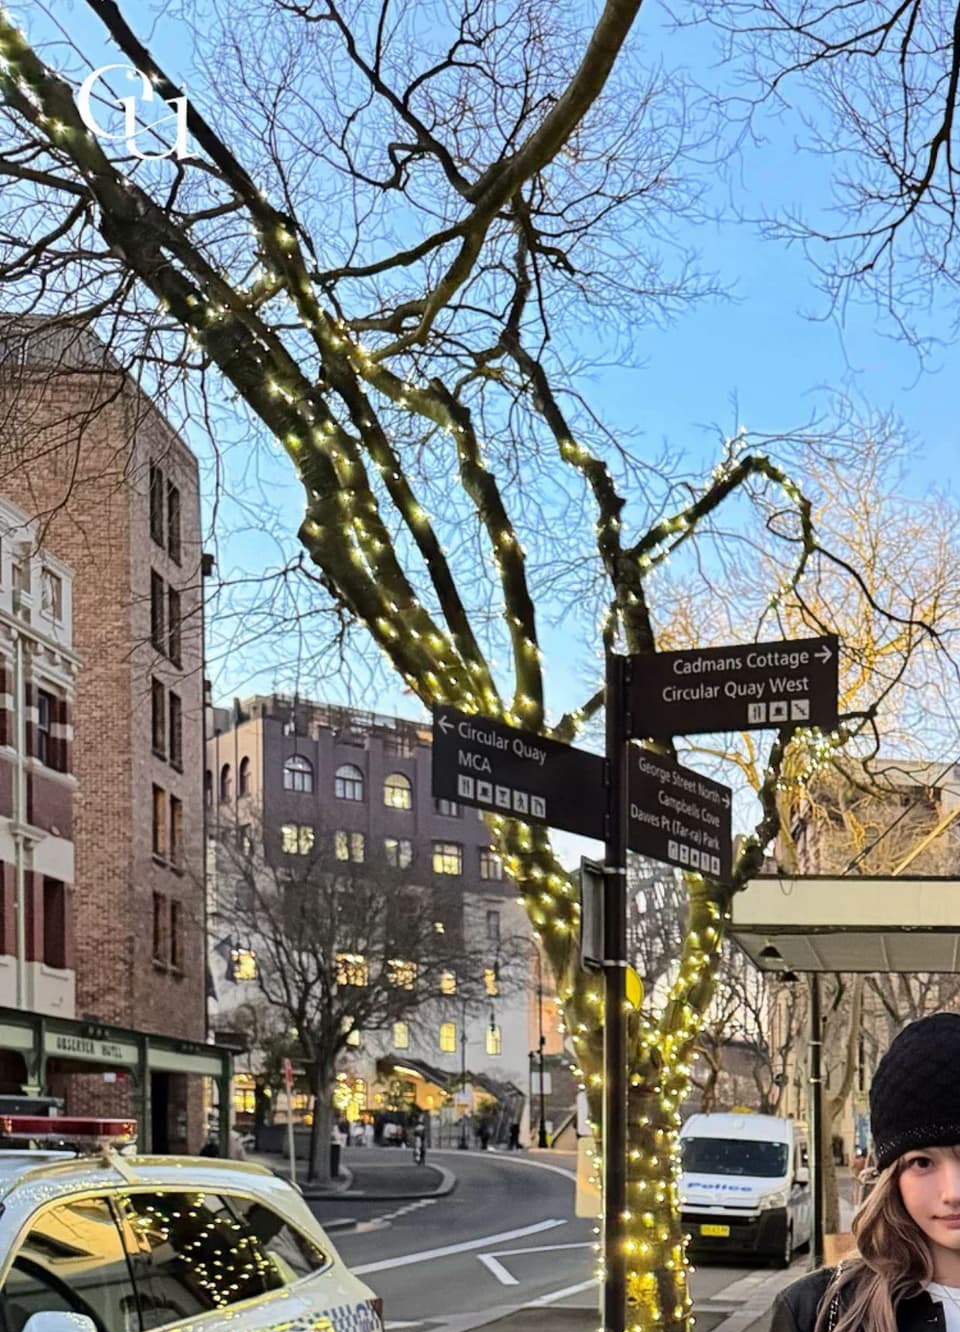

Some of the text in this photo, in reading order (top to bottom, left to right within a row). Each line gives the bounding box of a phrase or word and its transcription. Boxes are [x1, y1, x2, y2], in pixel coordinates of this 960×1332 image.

[673, 651, 810, 675] Cadmans Cottage
[662, 676, 810, 702] Circular Quay West
[458, 721, 547, 766] Circular Quay
[458, 749, 492, 774] MCA
[639, 757, 720, 803] George Street North
[658, 790, 721, 828] Campbells Cove
[630, 803, 660, 828] Dawes
[661, 815, 671, 832] Pt
[703, 831, 720, 851] Park
[687, 1182, 752, 1192] Police
